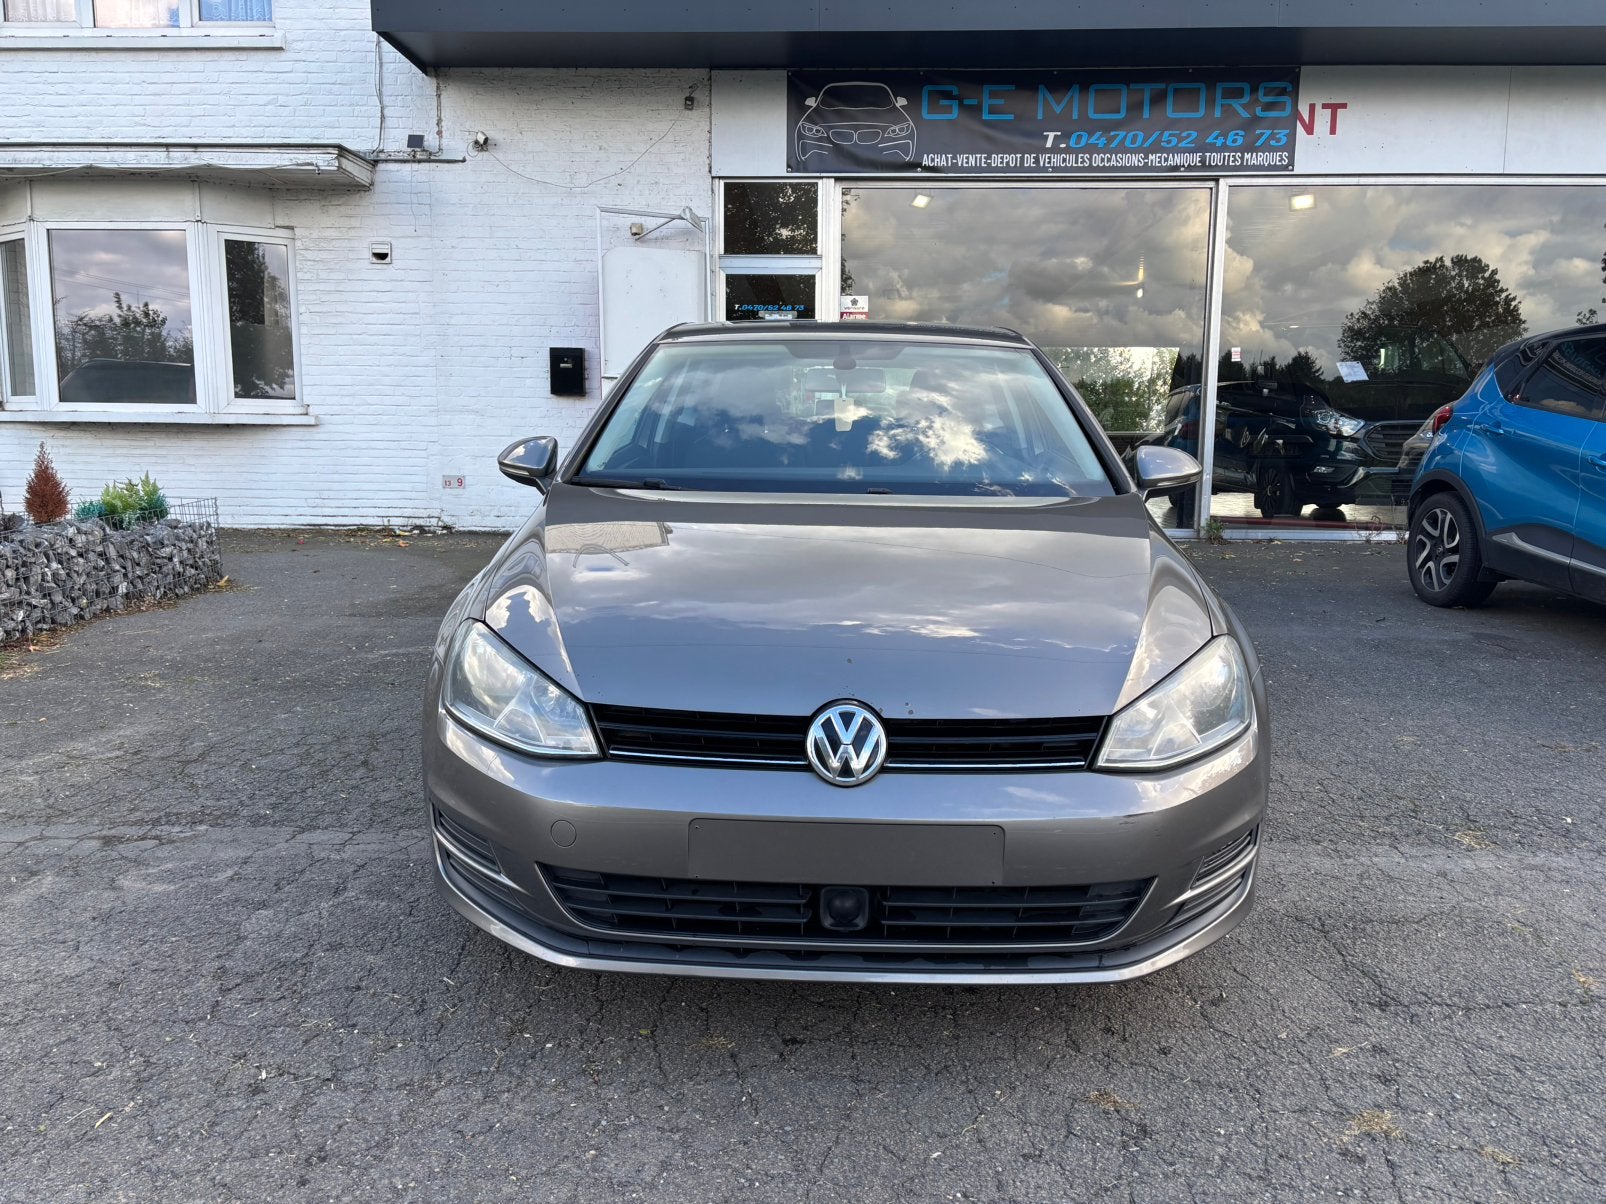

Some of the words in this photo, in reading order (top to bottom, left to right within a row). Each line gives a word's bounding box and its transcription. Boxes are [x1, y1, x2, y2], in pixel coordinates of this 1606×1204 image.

[921, 84, 1016, 120] G-E
[1036, 82, 1293, 120] MOTORS
[1043, 130, 1198, 149] T.0470/52
[1205, 129, 1246, 148] 46
[1255, 129, 1290, 147] 73
[922, 153, 1020, 168] ACHAT-VENTE-DEPOT
[1023, 153, 1036, 167] DE
[1039, 153, 1090, 168] VEHICULES
[1092, 152, 1203, 168] OCCASIONS-MECANIQUE
[1204, 152, 1241, 167] TOUTES
[1243, 151, 1289, 167] MARQUES
